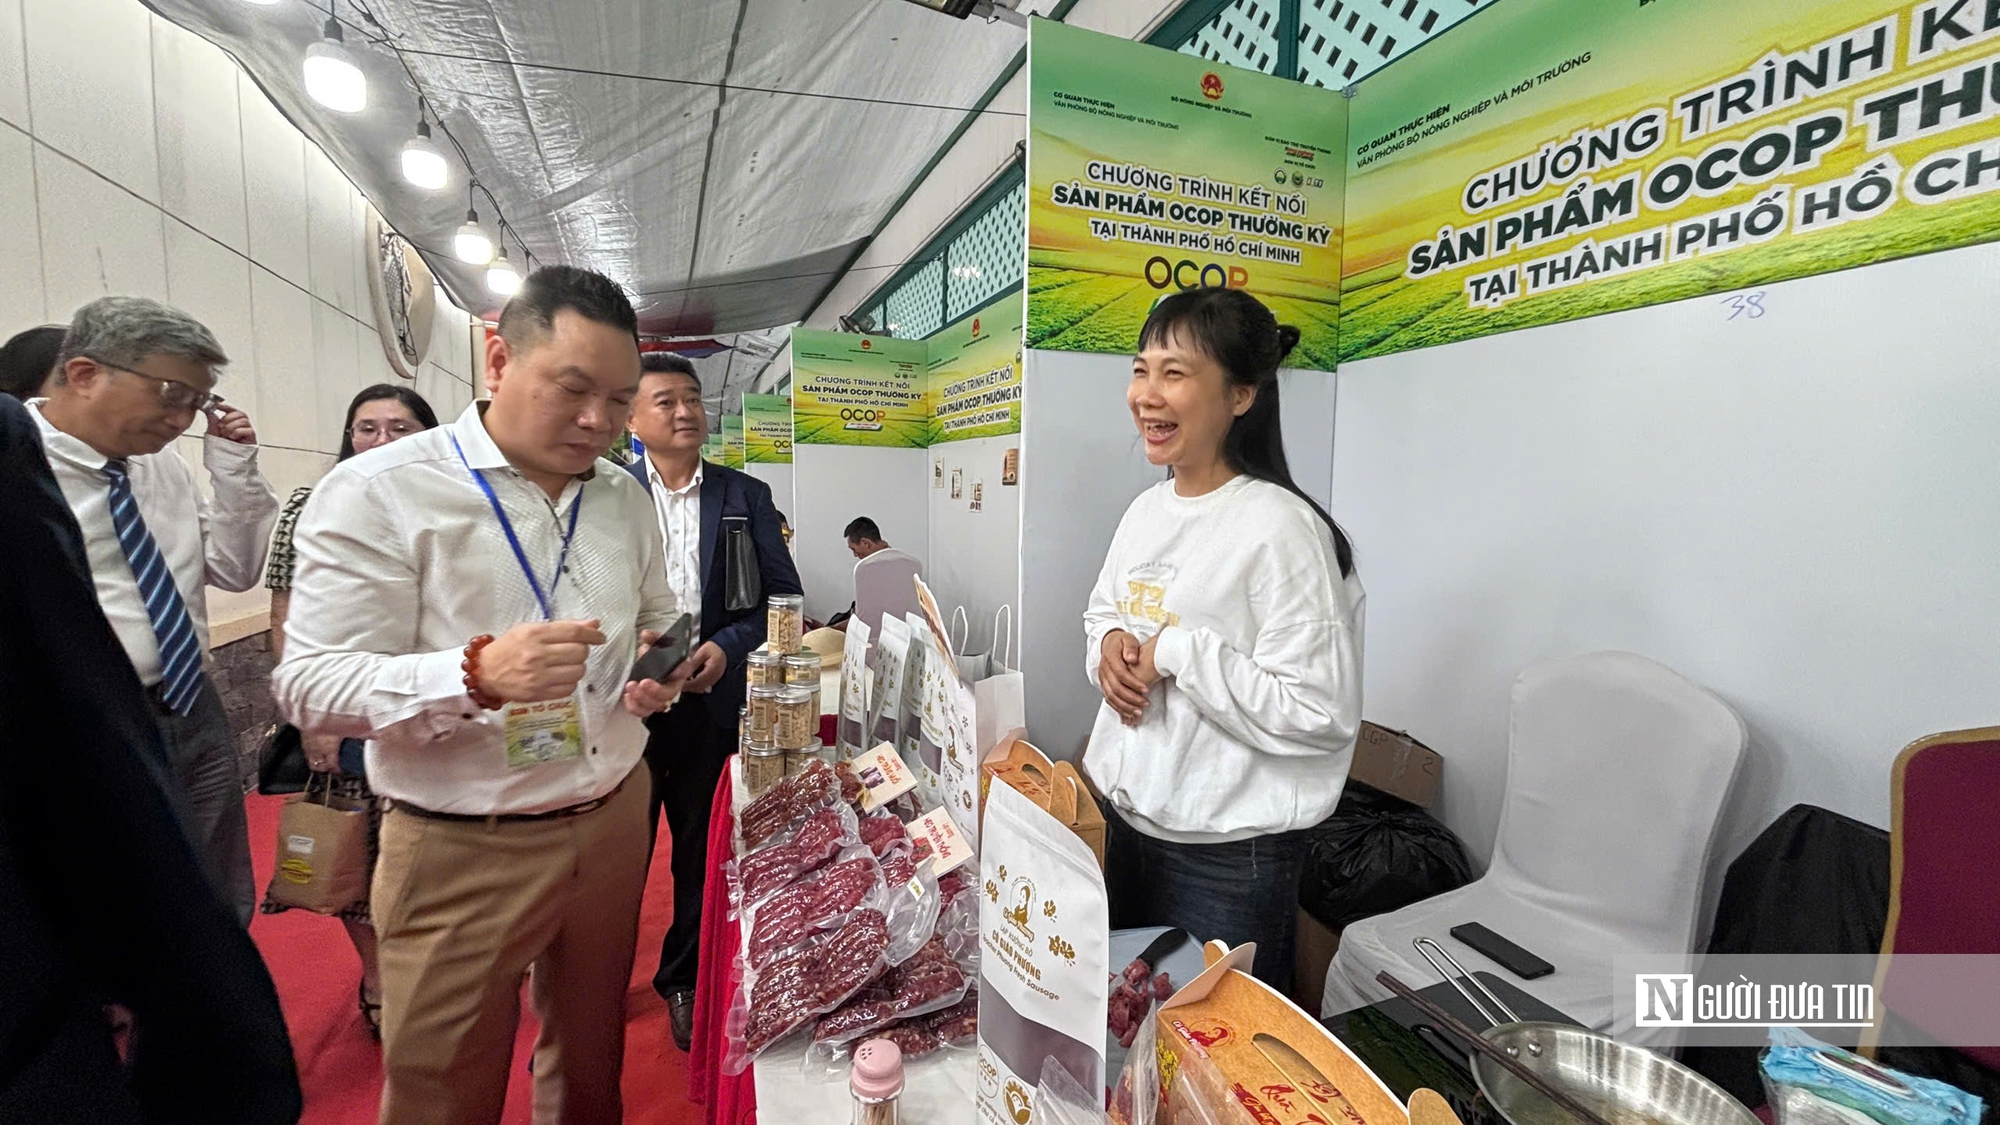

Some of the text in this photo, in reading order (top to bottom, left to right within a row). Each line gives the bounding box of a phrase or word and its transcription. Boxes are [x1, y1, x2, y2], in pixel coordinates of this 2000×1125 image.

[1064, 94, 1082, 102] QUAN
[1357, 51, 1591, 168] VĂN PHÒNG BỘ NÔNG NGHIỆP VÀ MÔI TRƯỜNG
[1466, 114, 1658, 209] CHƯƠNG
[1681, 26, 1886, 134] TRÌNH
[1371, 131, 1397, 149] QUAN
[1398, 116, 1424, 135] THỰC
[1426, 104, 1450, 124] HIỆN
[1410, 61, 2000, 275] SẢN PHẨM OCOP TH
[1087, 162, 1306, 215] CHƯƠNG TRÌNH KẾT NỐI
[1054, 184, 1331, 244] SẢN PHẨM OCOP THƯỜNG KỲ
[1470, 269, 1516, 302] TẠI
[1527, 232, 1661, 289] THÀNH
[1676, 191, 1784, 254] PHỐ
[1802, 163, 1892, 225] HỒ
[1091, 220, 1300, 263] TẠI THÀNH PHỐ HỒ CHÍ MINH
[1144, 255, 1249, 291] OCOP
[1720, 290, 1767, 321] 38
[850, 388, 873, 396] OCOP
[964, 395, 981, 410] OCOP
[840, 408, 886, 422] OCOP
[1013, 950, 1041, 981] PHƯỢNG
[1026, 978, 1060, 1001] Sausage
